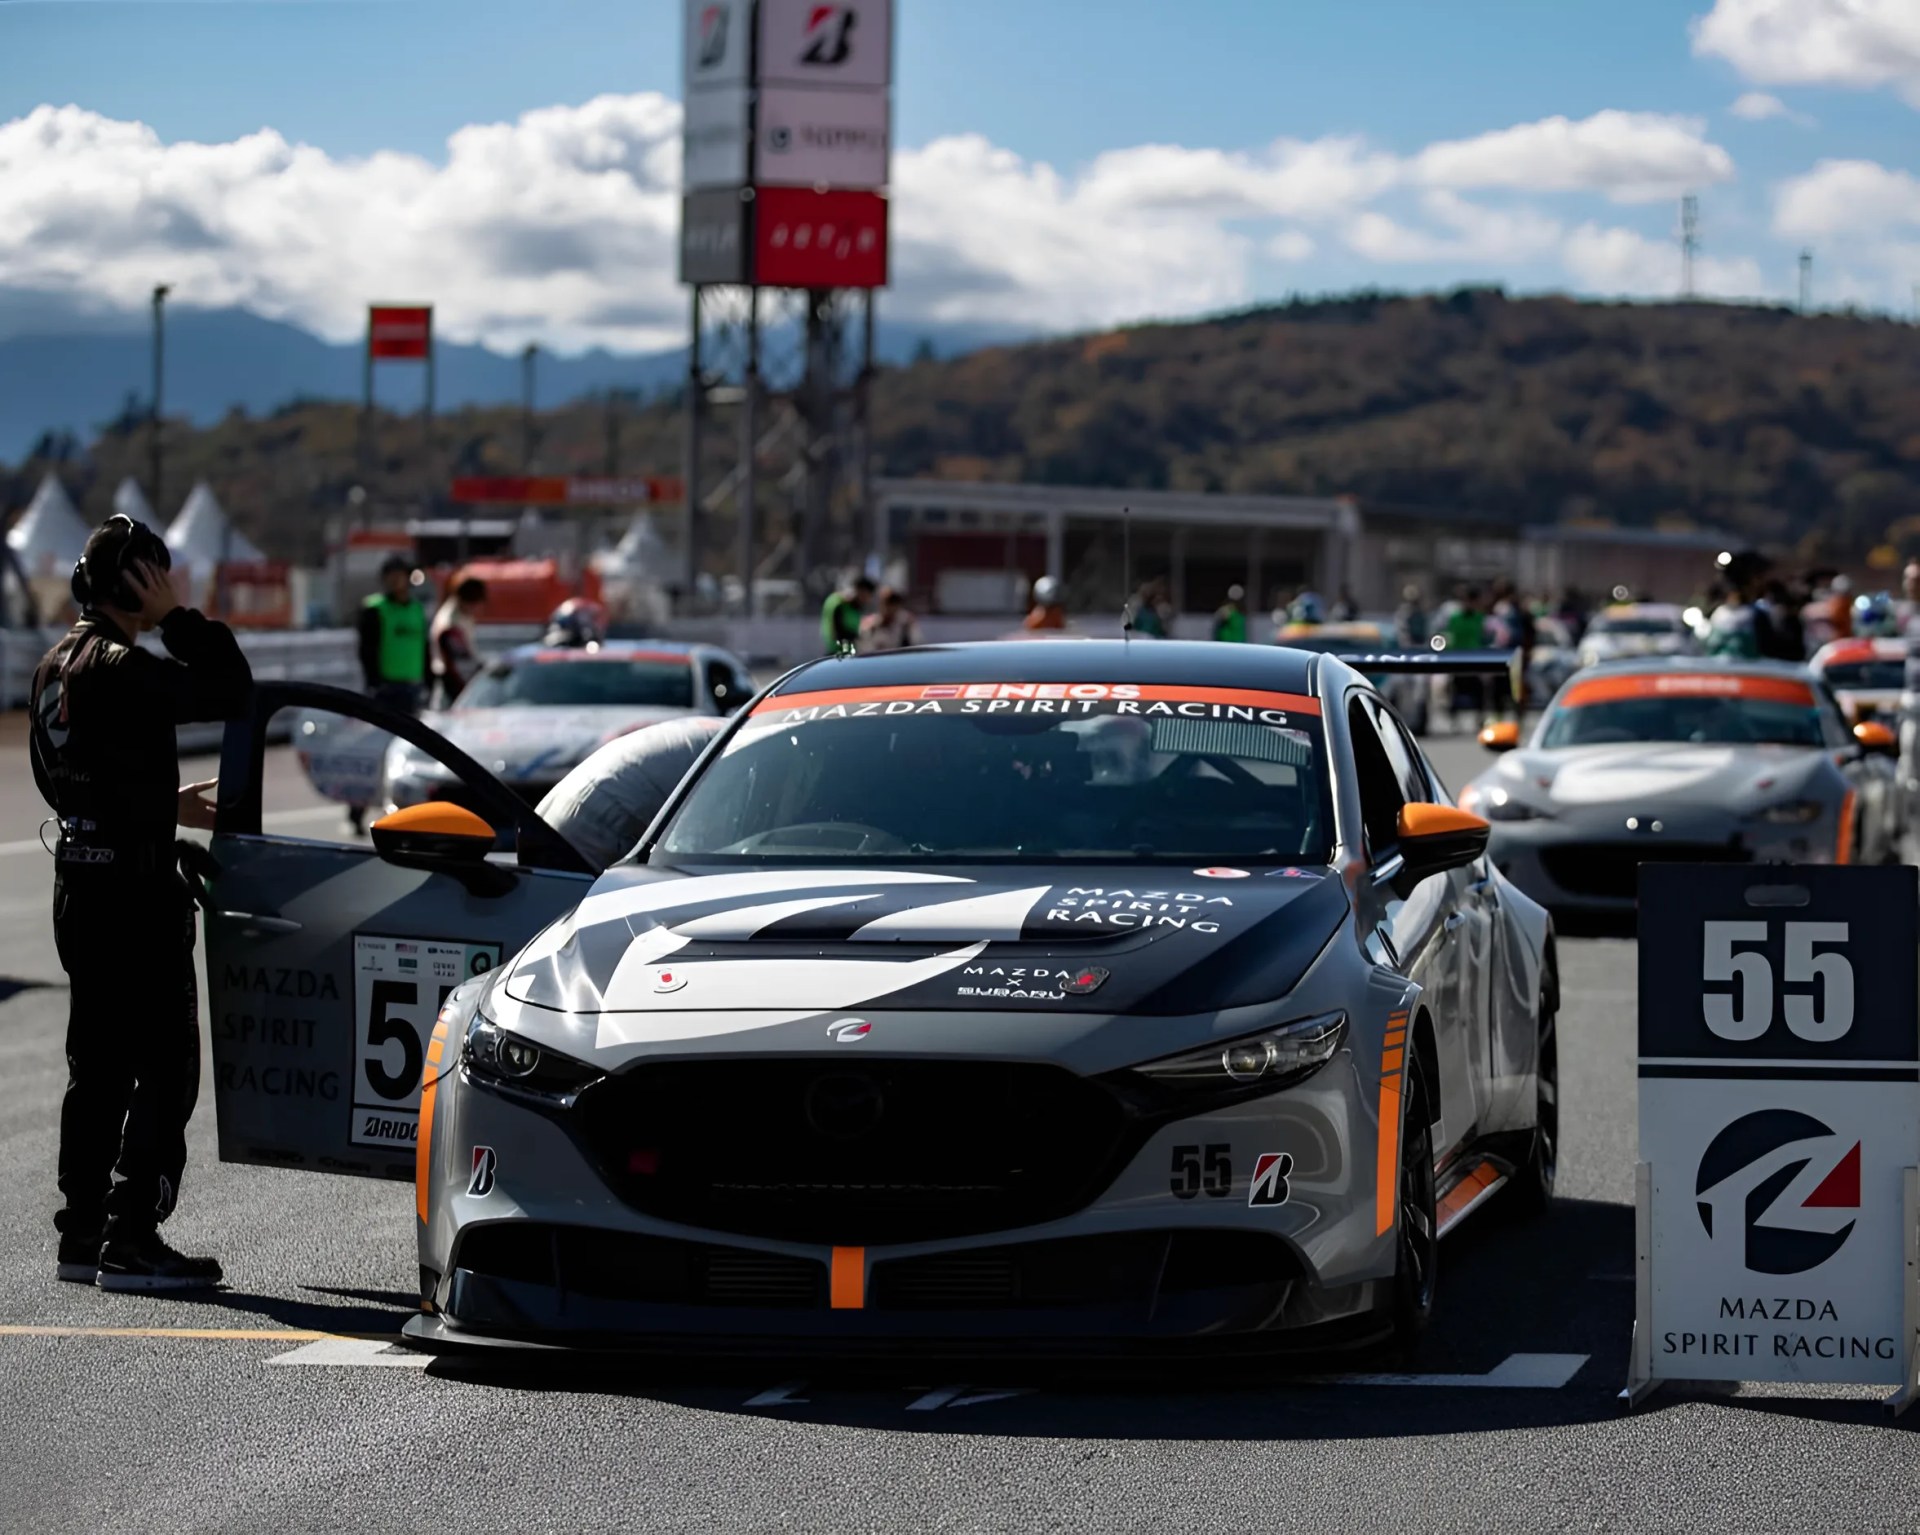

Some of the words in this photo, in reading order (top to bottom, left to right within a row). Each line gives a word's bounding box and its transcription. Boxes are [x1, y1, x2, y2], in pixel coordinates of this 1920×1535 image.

[964, 684, 1140, 699] ENEOS
[782, 701, 943, 722] MAZDA
[960, 699, 1098, 713] SPIRIT
[1116, 701, 1288, 725] RACING
[1057, 897, 1198, 914] SPIRIT
[1067, 888, 1234, 906] MAZDA
[1047, 909, 1221, 933] RACING
[224, 963, 340, 1000] MAZDA
[963, 967, 1070, 979] MAZDA
[1703, 920, 1855, 1042] 55
[957, 986, 1066, 1000] SUBARU
[223, 1013, 317, 1049] SPIRIT
[217, 1062, 340, 1101] RACING
[1170, 1144, 1232, 1199] 55
[1719, 1297, 1838, 1321] MAZDA
[1663, 1332, 1759, 1357] SPIRIT
[1773, 1334, 1895, 1360] RACING
